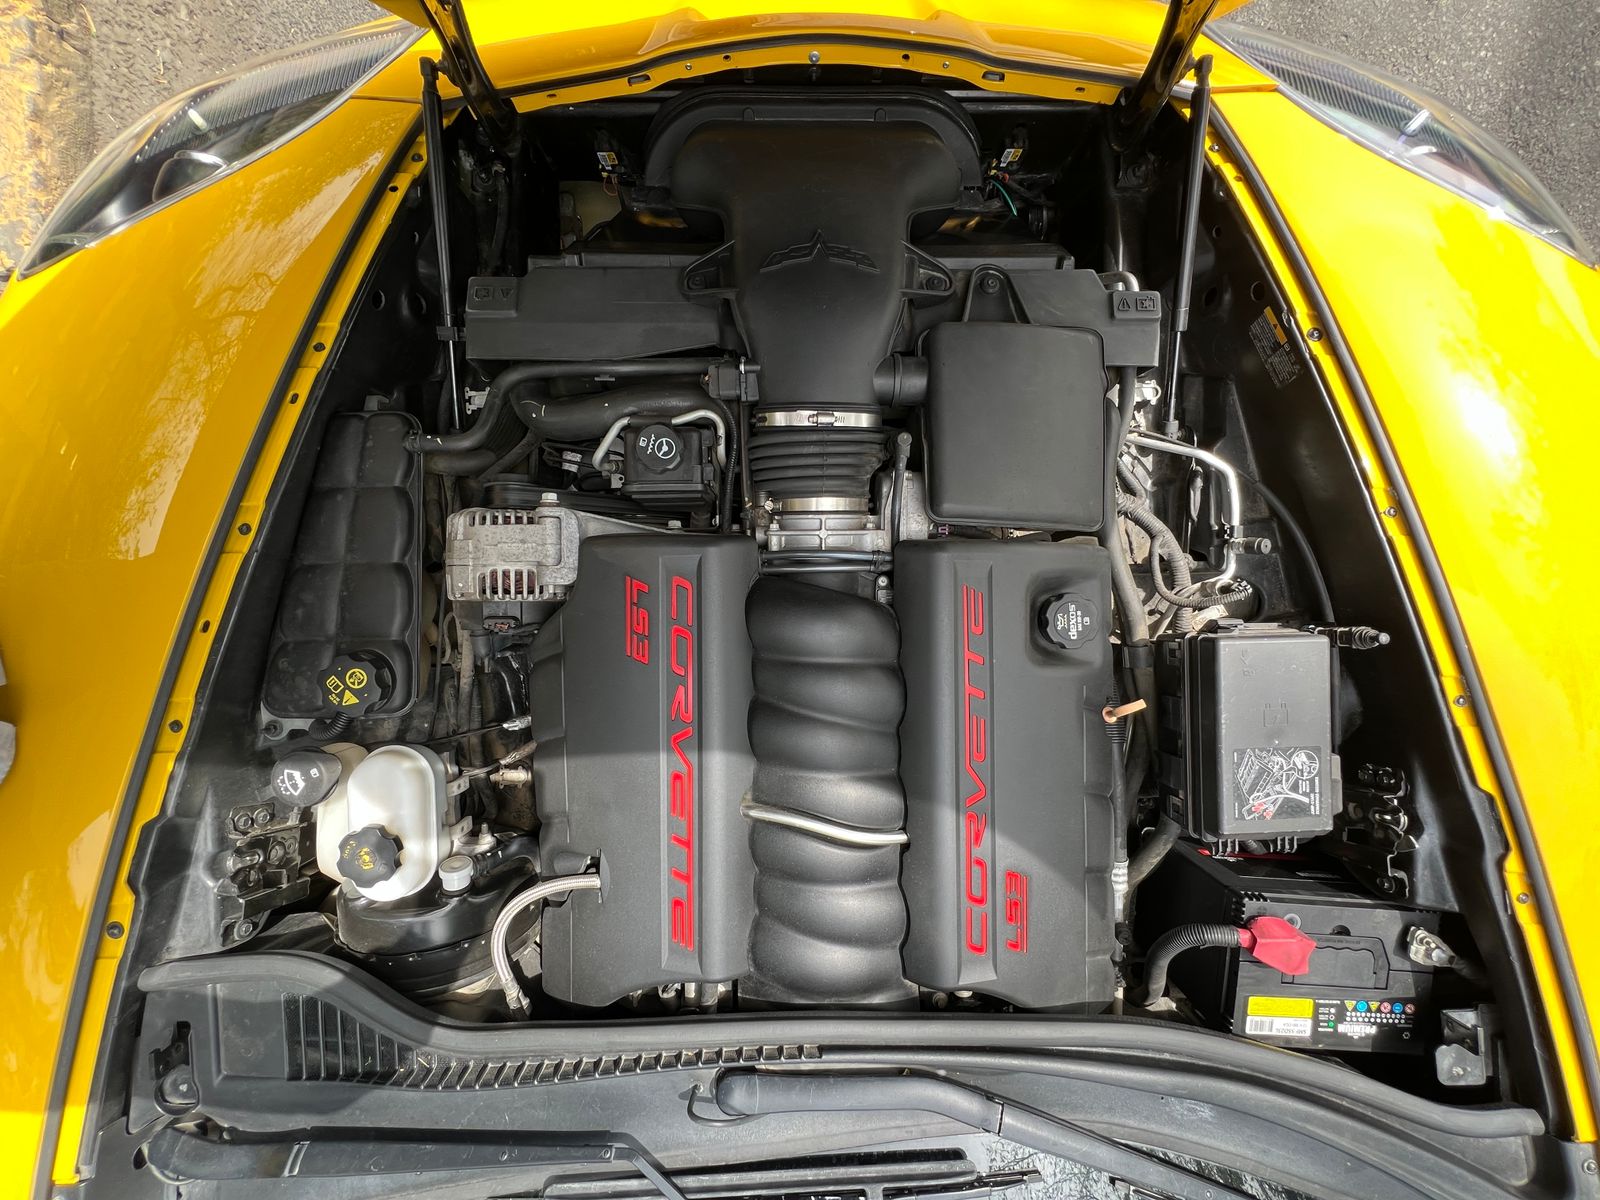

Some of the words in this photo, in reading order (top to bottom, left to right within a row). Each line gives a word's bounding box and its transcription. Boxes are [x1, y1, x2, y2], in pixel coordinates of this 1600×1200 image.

[625, 576, 650, 665] LS3
[1068, 603, 1077, 639] dexos
[669, 575, 696, 952] CORVETTE
[962, 585, 988, 956] CORVETTE
[1004, 869, 1028, 953] LS3
[1338, 1023, 1377, 1034] PREMIUM
